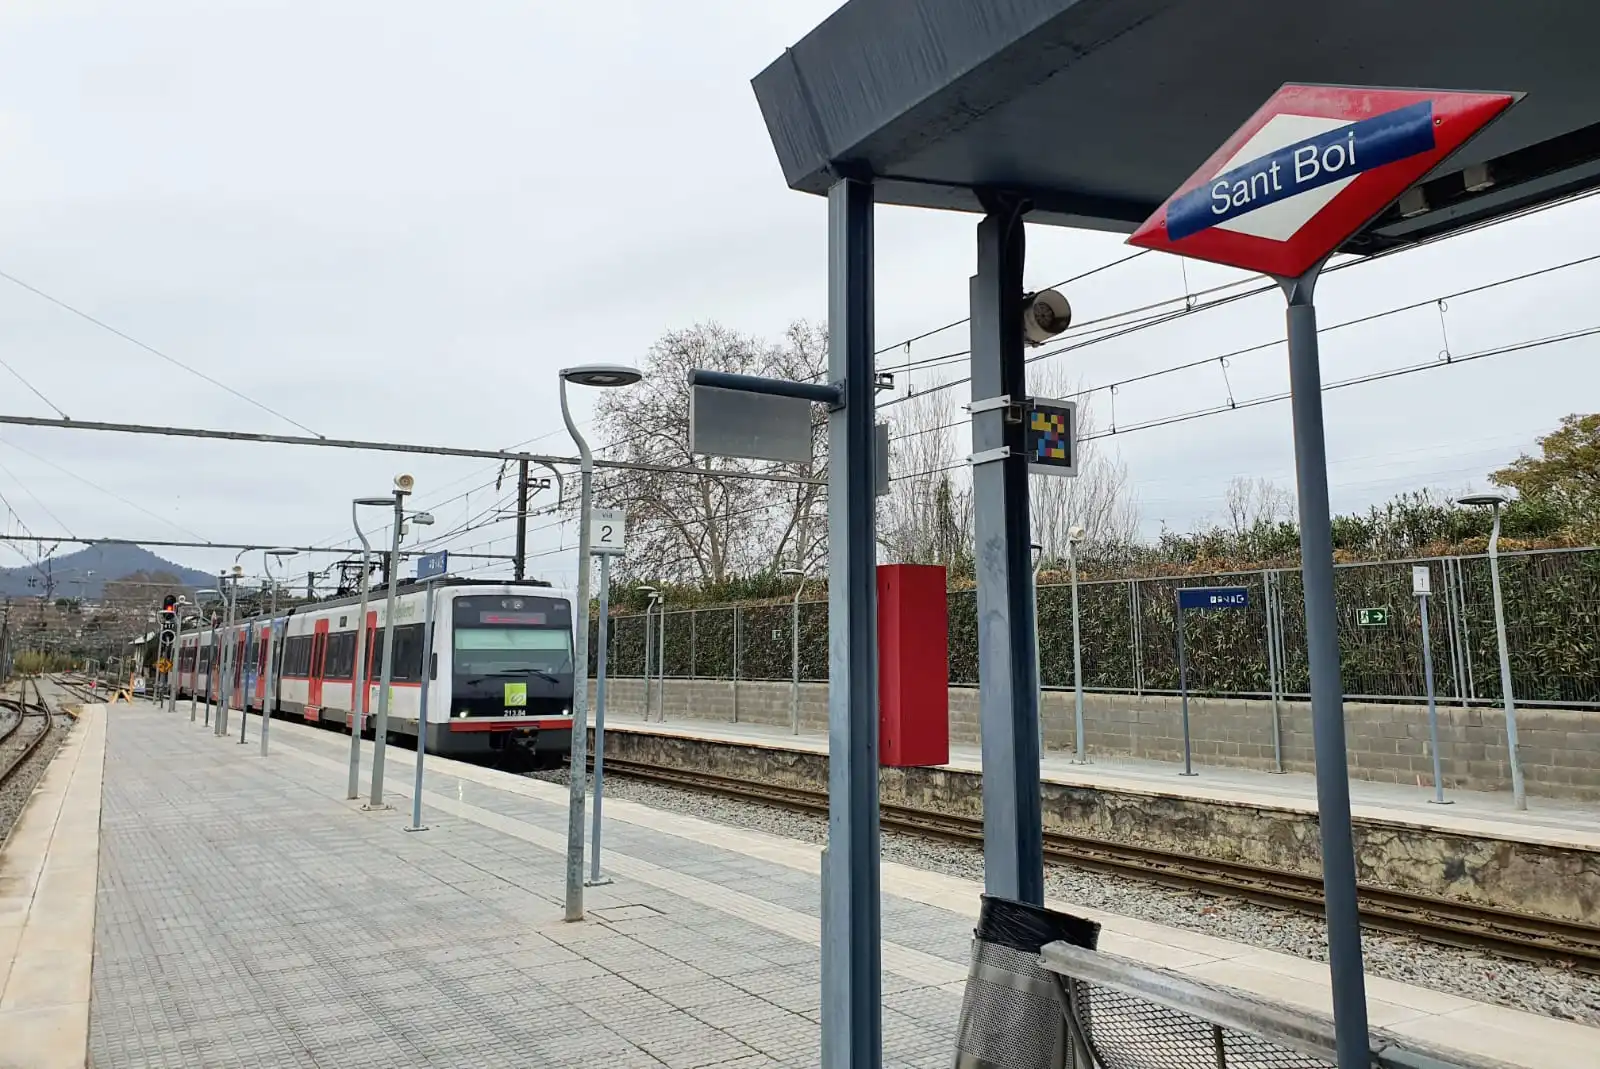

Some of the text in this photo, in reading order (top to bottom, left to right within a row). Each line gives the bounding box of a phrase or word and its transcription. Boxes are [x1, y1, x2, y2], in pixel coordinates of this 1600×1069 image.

[1211, 131, 1356, 215] Sant Boi
[601, 525, 612, 542] 2
